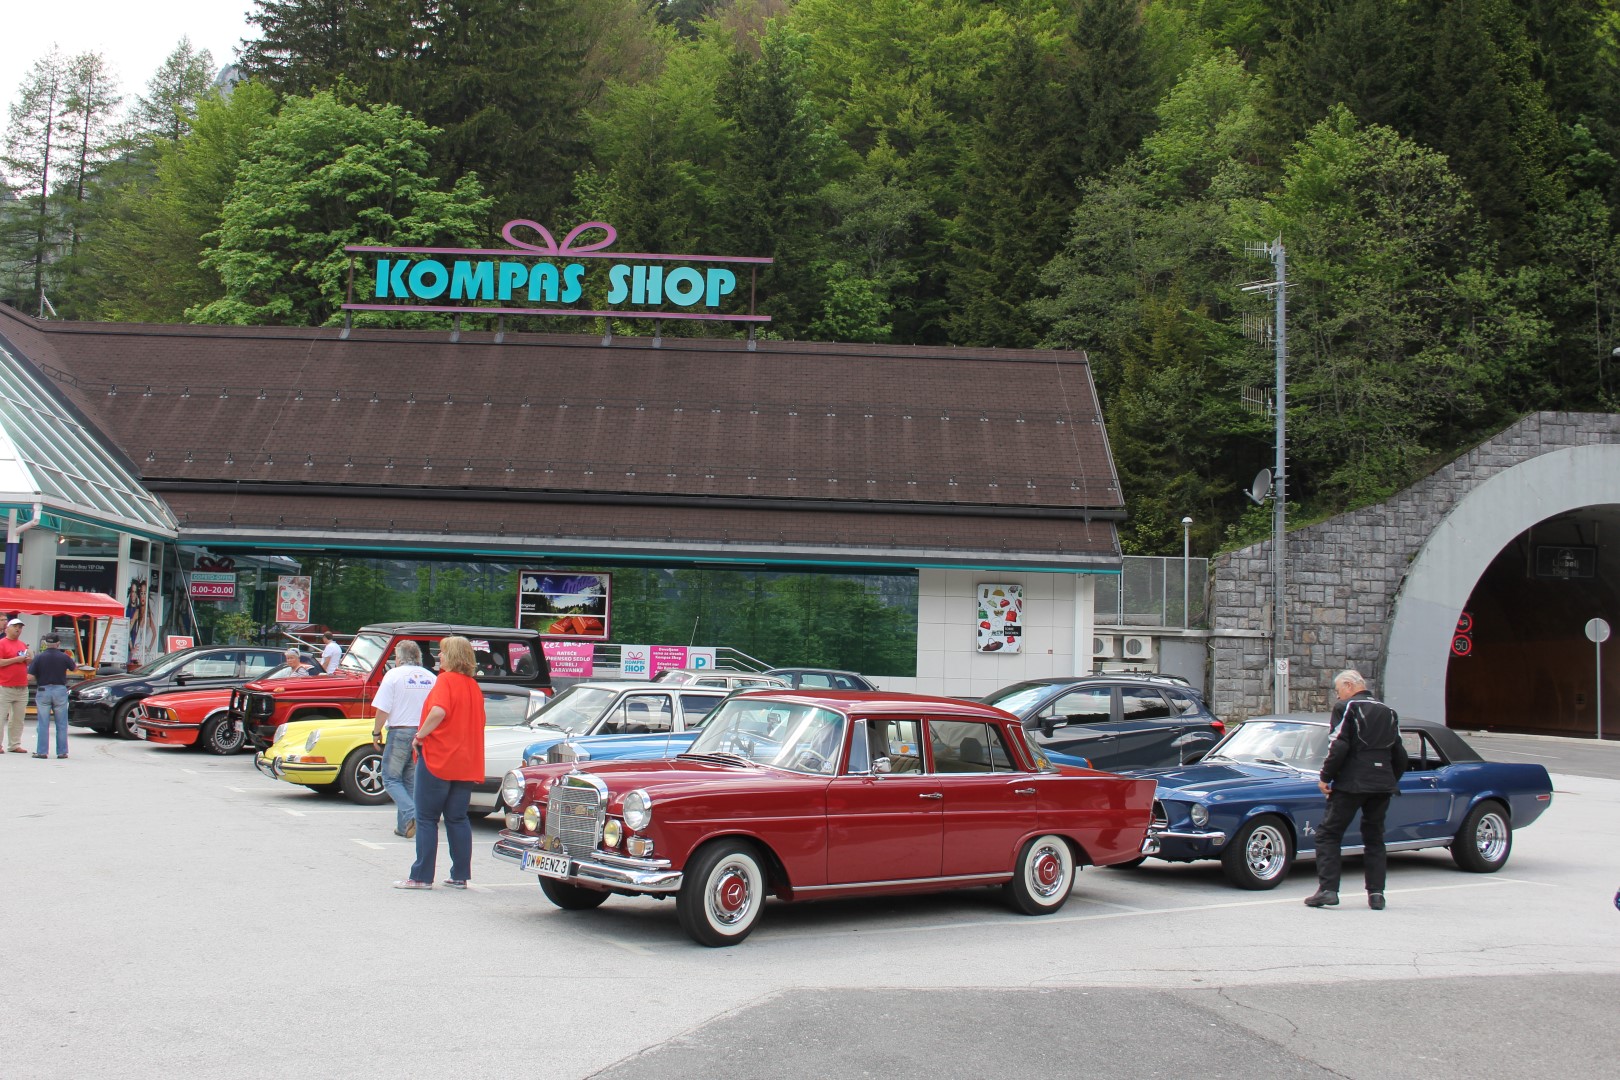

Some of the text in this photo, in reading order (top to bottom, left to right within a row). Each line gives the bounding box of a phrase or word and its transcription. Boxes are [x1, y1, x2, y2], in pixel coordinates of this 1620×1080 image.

[375, 259, 736, 307] KOMPAS SHOP
[1455, 640, 1468, 650] 50
[695, 657, 706, 669] P
[540, 856, 560, 872] BENZ
[560, 860, 567, 874] 3
